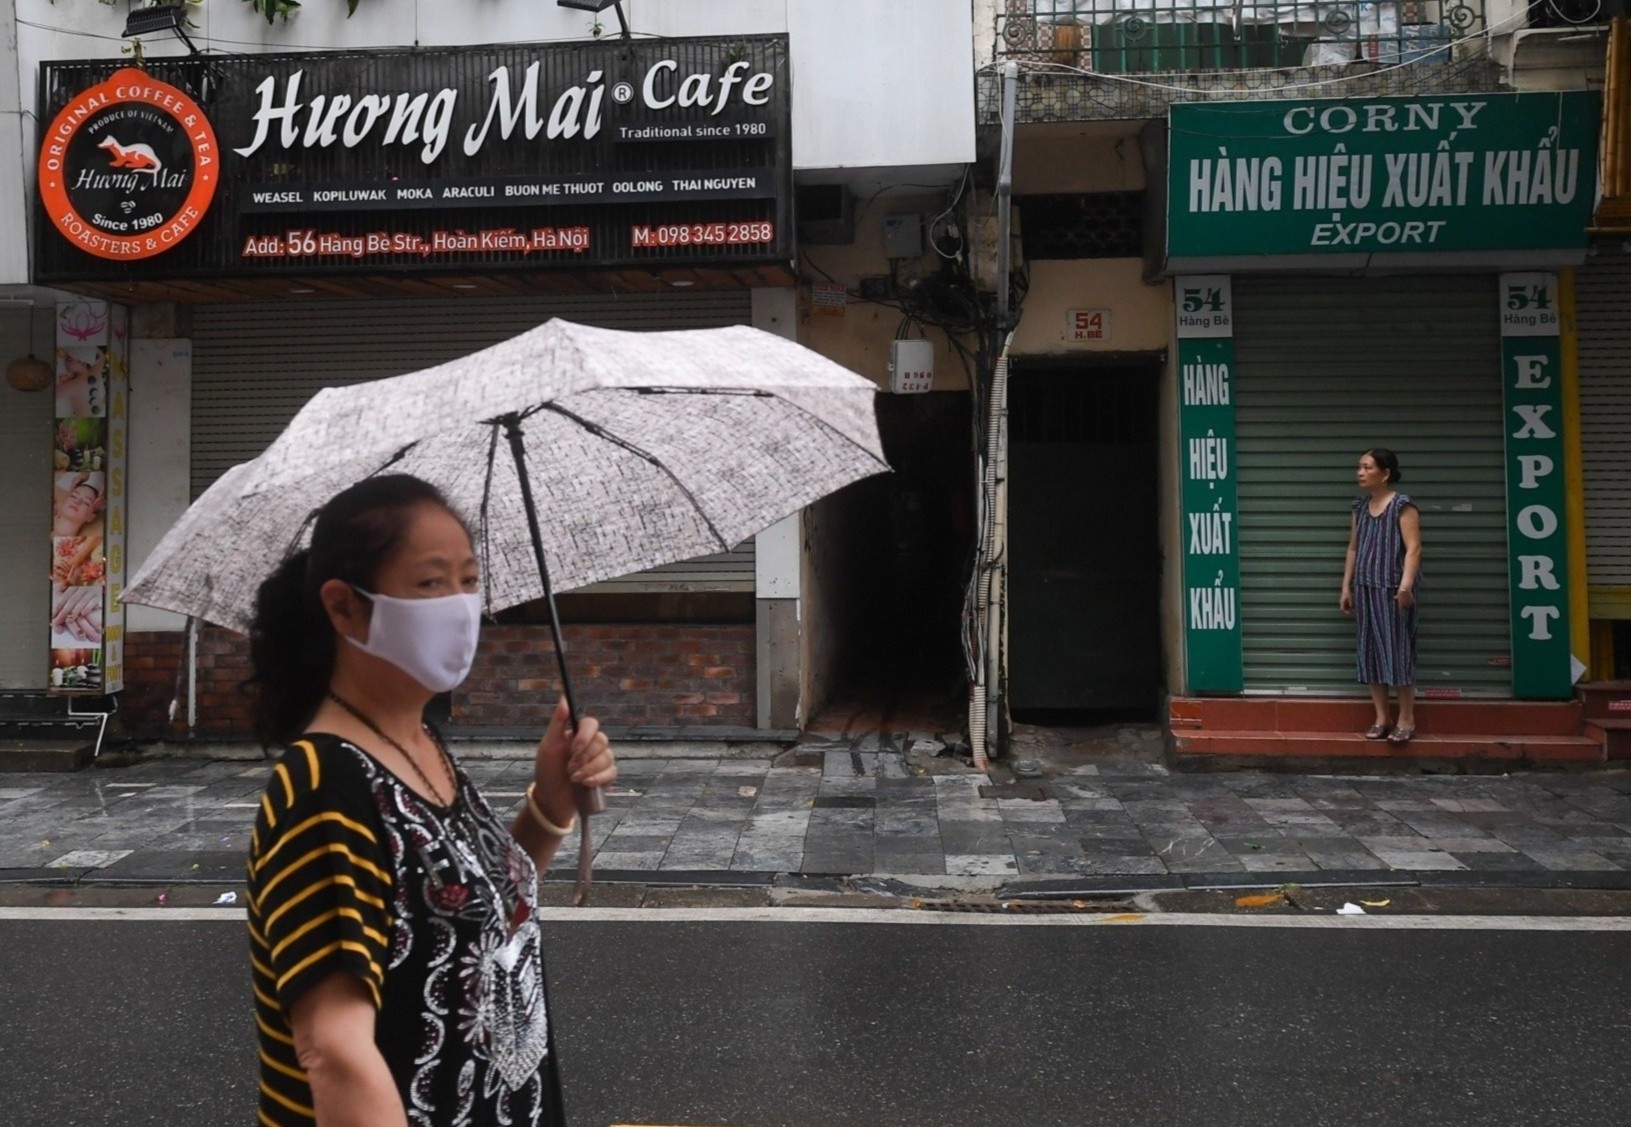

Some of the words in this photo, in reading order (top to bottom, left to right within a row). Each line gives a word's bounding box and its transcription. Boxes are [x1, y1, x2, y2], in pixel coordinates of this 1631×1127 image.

[88, 111, 125, 134] PRODUCE
[127, 110, 138, 118] OF
[140, 111, 174, 133] VIETNAM
[233, 69, 458, 164] Hương
[464, 61, 604, 156] Mai
[643, 59, 774, 115] Cafe
[1283, 102, 1487, 135] CORNY
[47, 92, 109, 171] ORIGINAL
[116, 86, 184, 114] COFFEE
[184, 115, 196, 128] &
[195, 131, 212, 167] TEA
[620, 125, 691, 138] Traditional
[696, 124, 731, 136] since
[735, 123, 766, 135] 1980
[1188, 147, 1282, 213] HÀNG
[1293, 144, 1373, 221] HIỆU
[1382, 132, 1474, 208] XUẤT
[1482, 126, 1579, 205] KHẨU
[253, 191, 303, 203] WEASEL
[313, 190, 387, 202] KOPILUWAK
[397, 188, 433, 200] MOKA
[443, 186, 495, 198] ARACULI
[505, 185, 540, 196] BUON
[542, 184, 561, 195] ME
[564, 183, 604, 194] THUOT
[613, 181, 663, 193] OOLONG
[672, 180, 701, 191] THAI
[704, 177, 756, 190] NGUYEN
[61, 212, 141, 254] ROASTERS
[146, 237, 157, 250] &
[161, 206, 199, 242] CAFE
[92, 213, 128, 231] Since
[132, 212, 163, 230] 1980
[634, 228, 655, 244] M:
[658, 227, 689, 243] 098
[693, 225, 725, 242] 345
[729, 224, 771, 241] 2858
[1310, 221, 1446, 246] EXPORT
[246, 239, 284, 254] Add:
[288, 231, 316, 254] 56
[320, 235, 363, 256] Hàng
[368, 234, 390, 250] Bè
[394, 234, 429, 253] Str.,
[434, 230, 477, 249] Hoàn
[534, 228, 556, 248] Hà
[560, 229, 588, 251] Nội
[1182, 287, 1226, 312] 54
[1507, 285, 1552, 310] 54
[1075, 312, 1102, 329] 54
[1180, 315, 1210, 328] Hàng
[1504, 313, 1536, 326] Hàng
[1183, 356, 1230, 406] HÀNG
[1189, 429, 1228, 489] HIỆU
[1512, 354, 1561, 641] EXPORT
[1188, 496, 1231, 555] XUẤT
[1190, 570, 1236, 630] KHẨU
